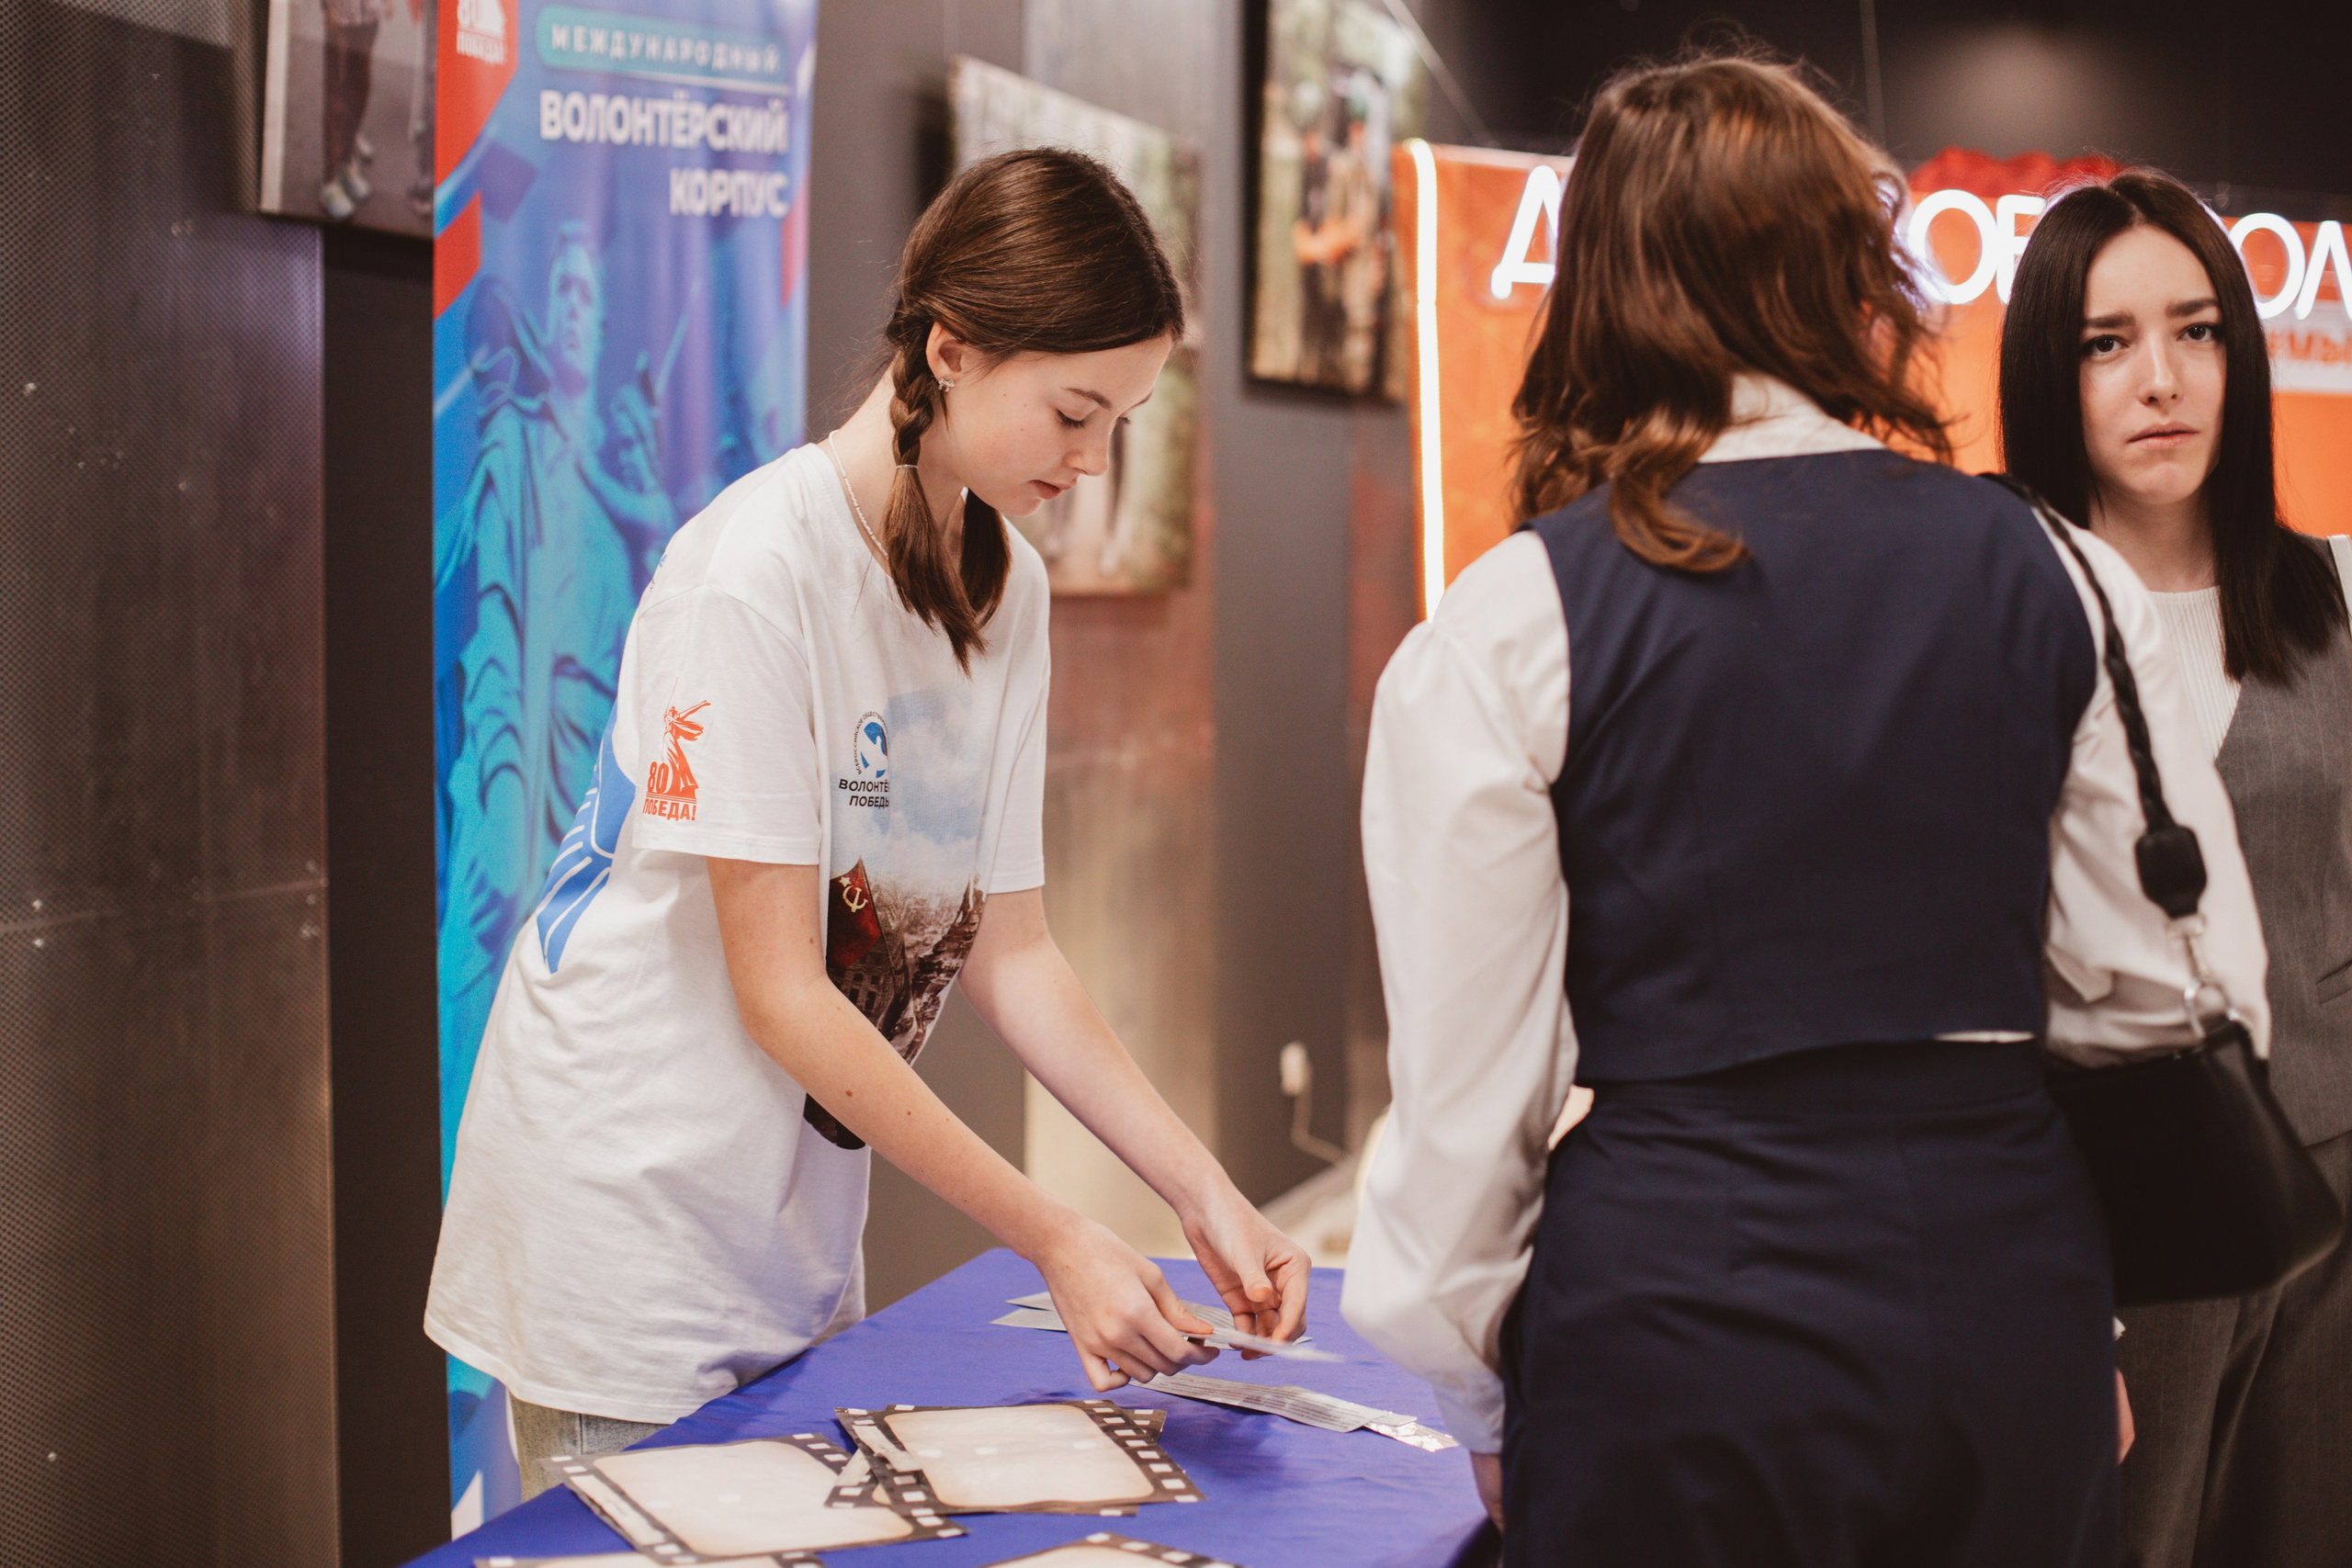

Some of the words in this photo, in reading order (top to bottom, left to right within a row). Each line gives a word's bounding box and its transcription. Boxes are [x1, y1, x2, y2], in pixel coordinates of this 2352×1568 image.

[551, 24, 781, 73] МЕЖДУНАРОДНЫЙ
[539, 89, 789, 154] ВОЛОНТЁРСКИЙ
[669, 166, 789, 219] КОРПУС
[648, 761, 669, 794] 80
[838, 778, 890, 793] ВОЛОНТЁ
[642, 797, 697, 822] ПОБЕДА!
